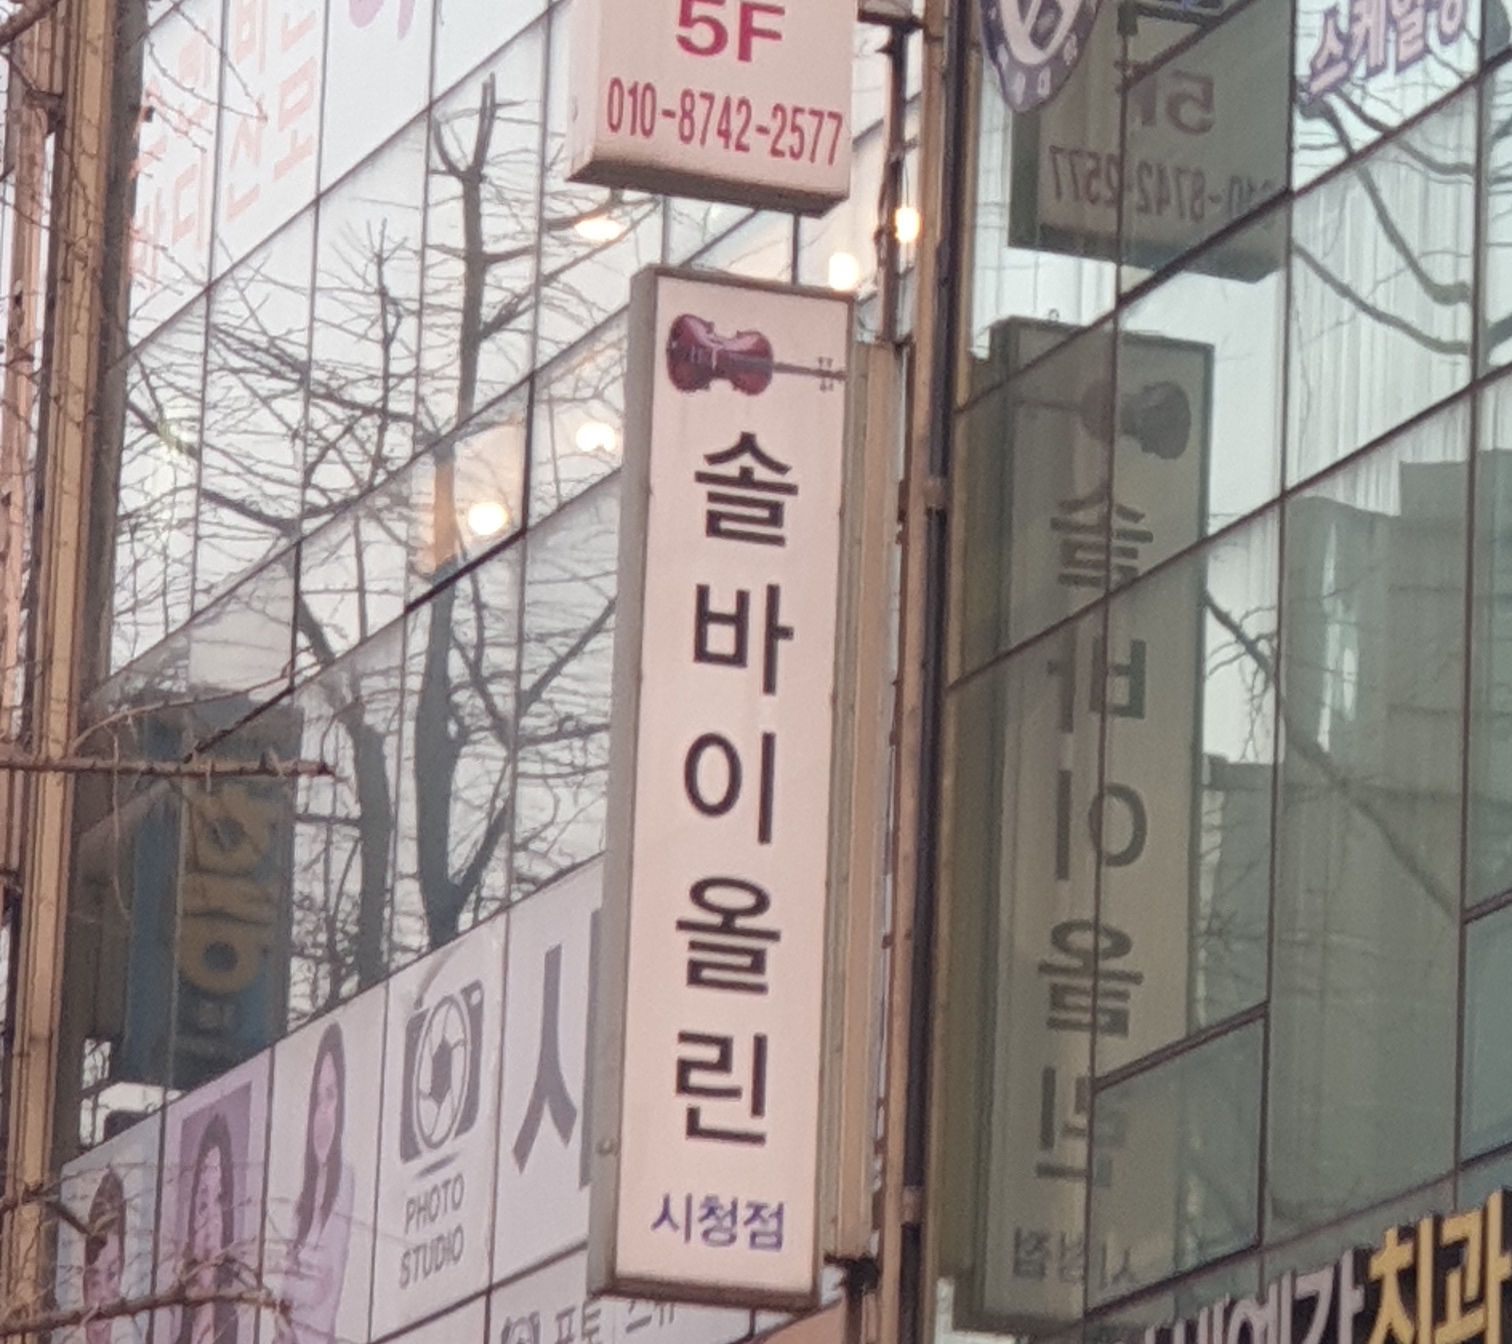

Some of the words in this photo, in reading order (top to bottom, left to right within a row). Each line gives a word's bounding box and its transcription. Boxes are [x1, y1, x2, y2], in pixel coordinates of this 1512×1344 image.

[606, 75, 844, 166] 010-8742-2577
[674, 430, 799, 1148] 솔바이올린
[404, 1171, 466, 1238] PHOTO
[650, 1192, 786, 1252] 시청점
[398, 1234, 466, 1290] STUDIO
